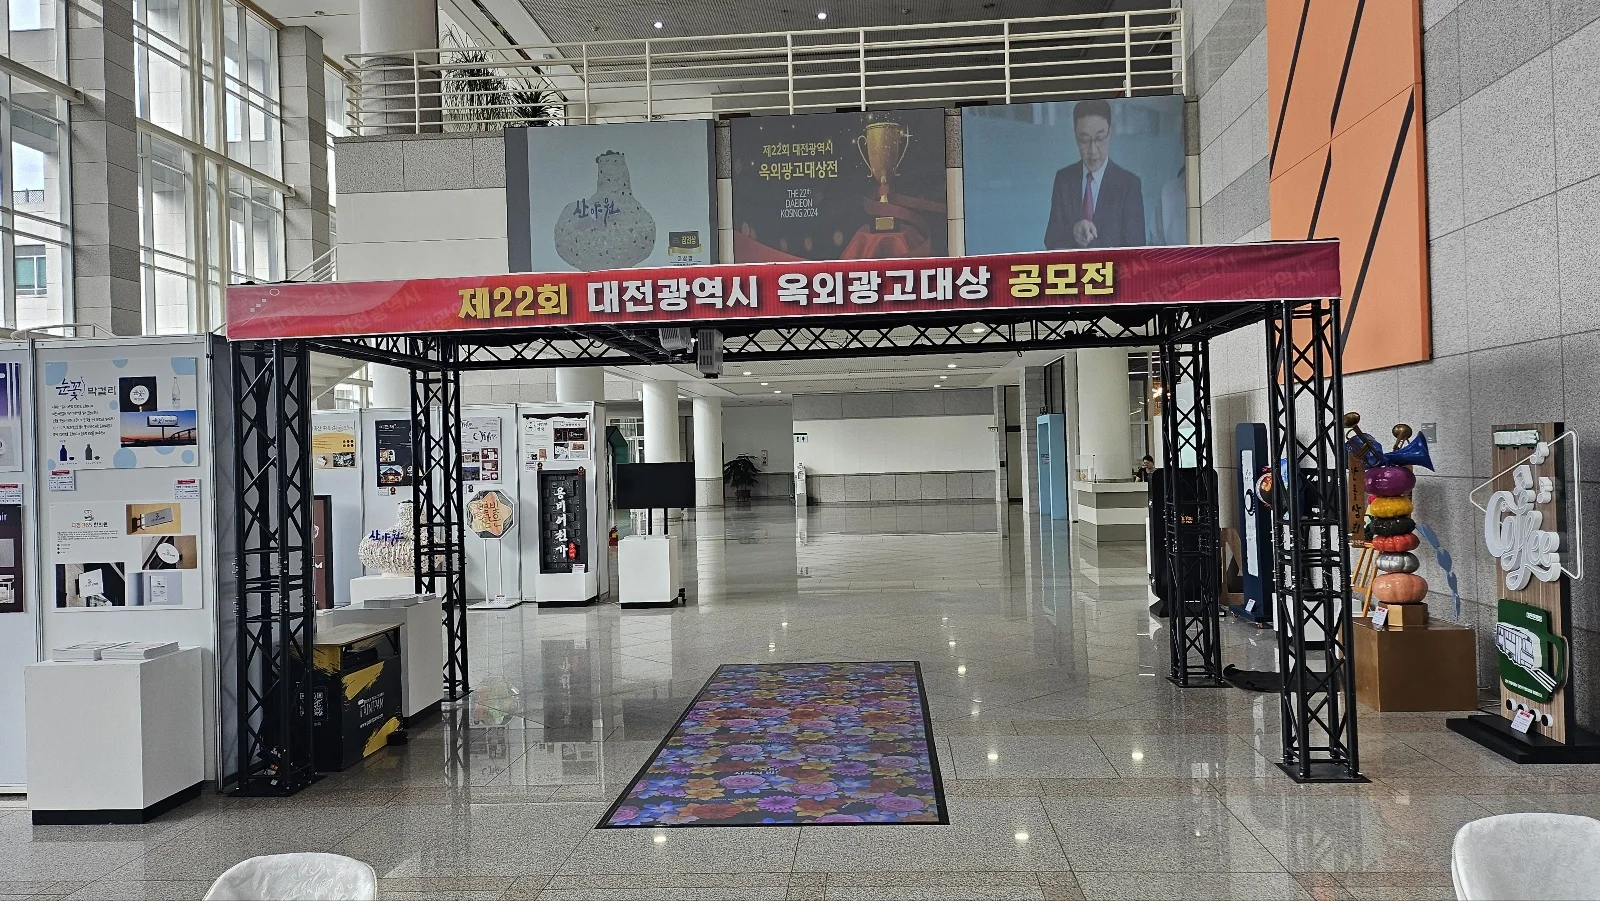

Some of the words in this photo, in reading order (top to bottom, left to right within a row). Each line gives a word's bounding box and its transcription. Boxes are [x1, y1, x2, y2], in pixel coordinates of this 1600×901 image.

[762, 143, 790, 157] 제22회
[792, 142, 833, 156] 대전광역시
[758, 160, 838, 180] 옥외광고대상전
[786, 189, 799, 198] THE
[799, 187, 812, 198] 22th
[803, 207, 819, 217] 2024
[457, 283, 568, 320] 제22회
[587, 275, 758, 313] 대전광역시
[776, 265, 991, 306] 옥외광고대상
[1008, 261, 1115, 298] 공모전
[87, 385, 117, 397] 막걸리
[553, 486, 569, 558] 용비어천가
[1484, 490, 1562, 591] Coffee
